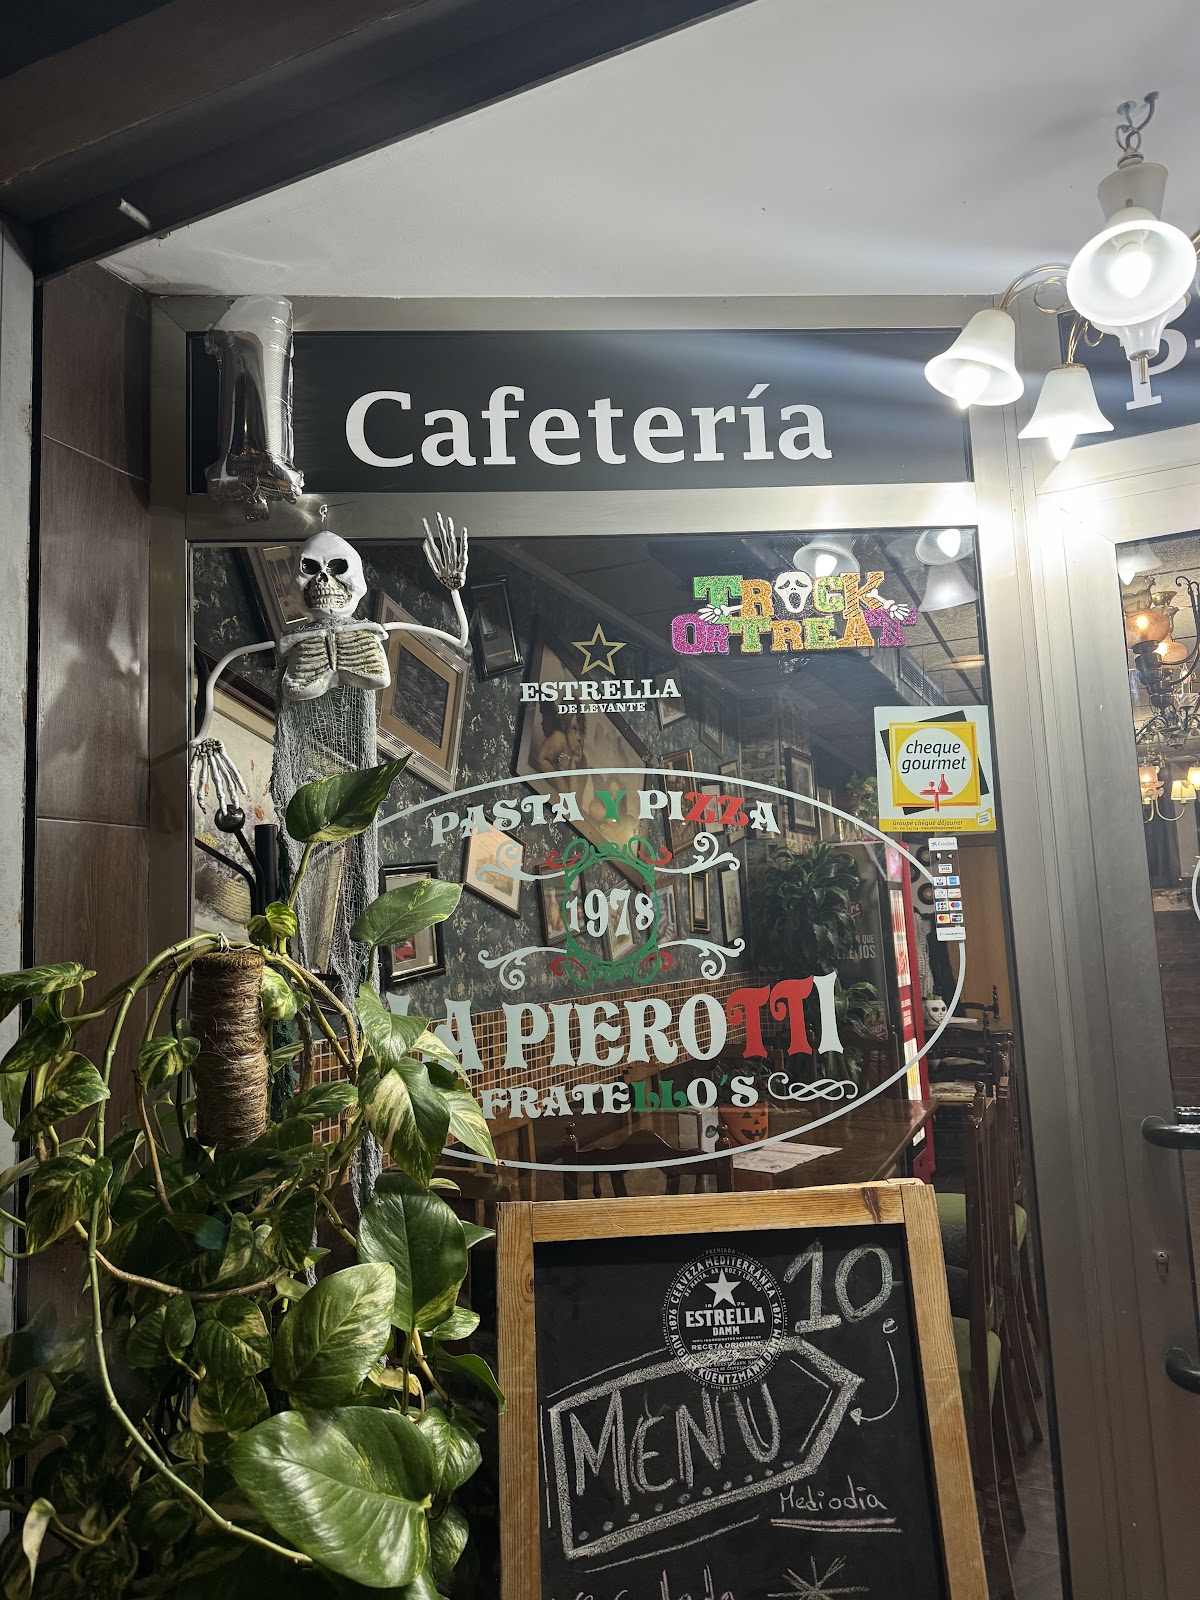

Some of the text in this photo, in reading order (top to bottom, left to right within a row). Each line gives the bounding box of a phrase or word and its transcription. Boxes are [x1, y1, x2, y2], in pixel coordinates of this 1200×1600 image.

[345, 384, 833, 468] Cafetería
[693, 571, 885, 627] TRCK
[728, 607, 918, 654] TREAT
[519, 678, 682, 702] ESTRELLA
[557, 702, 646, 715] DE LEVANTE
[901, 756, 967, 773] gourmet
[905, 739, 961, 757] cheque
[430, 789, 781, 847] PASTA Y PIZZA
[892, 819, 914, 827] Groupe
[937, 818, 963, 827] déjeuner
[565, 888, 655, 939] 1978
[501, 970, 845, 1072] PIEROTTI
[480, 1074, 760, 1120] FRATELLO'S
[671, 1262, 705, 1304] CERVEZA
[705, 1255, 776, 1298] MEDITERRÁNEA
[771, 1302, 782, 1325] 1876
[783, 1240, 893, 1333] 10
[685, 1306, 766, 1328] ESTRELLA
[712, 1326, 741, 1336] DAMM
[668, 1308, 678, 1330] 1876
[698, 1358, 767, 1384] KUENTZMANN
[764, 1328, 782, 1361] DAMM
[691, 1341, 763, 1351] RECETA ORIGINAL
[569, 1382, 781, 1505] MENU
